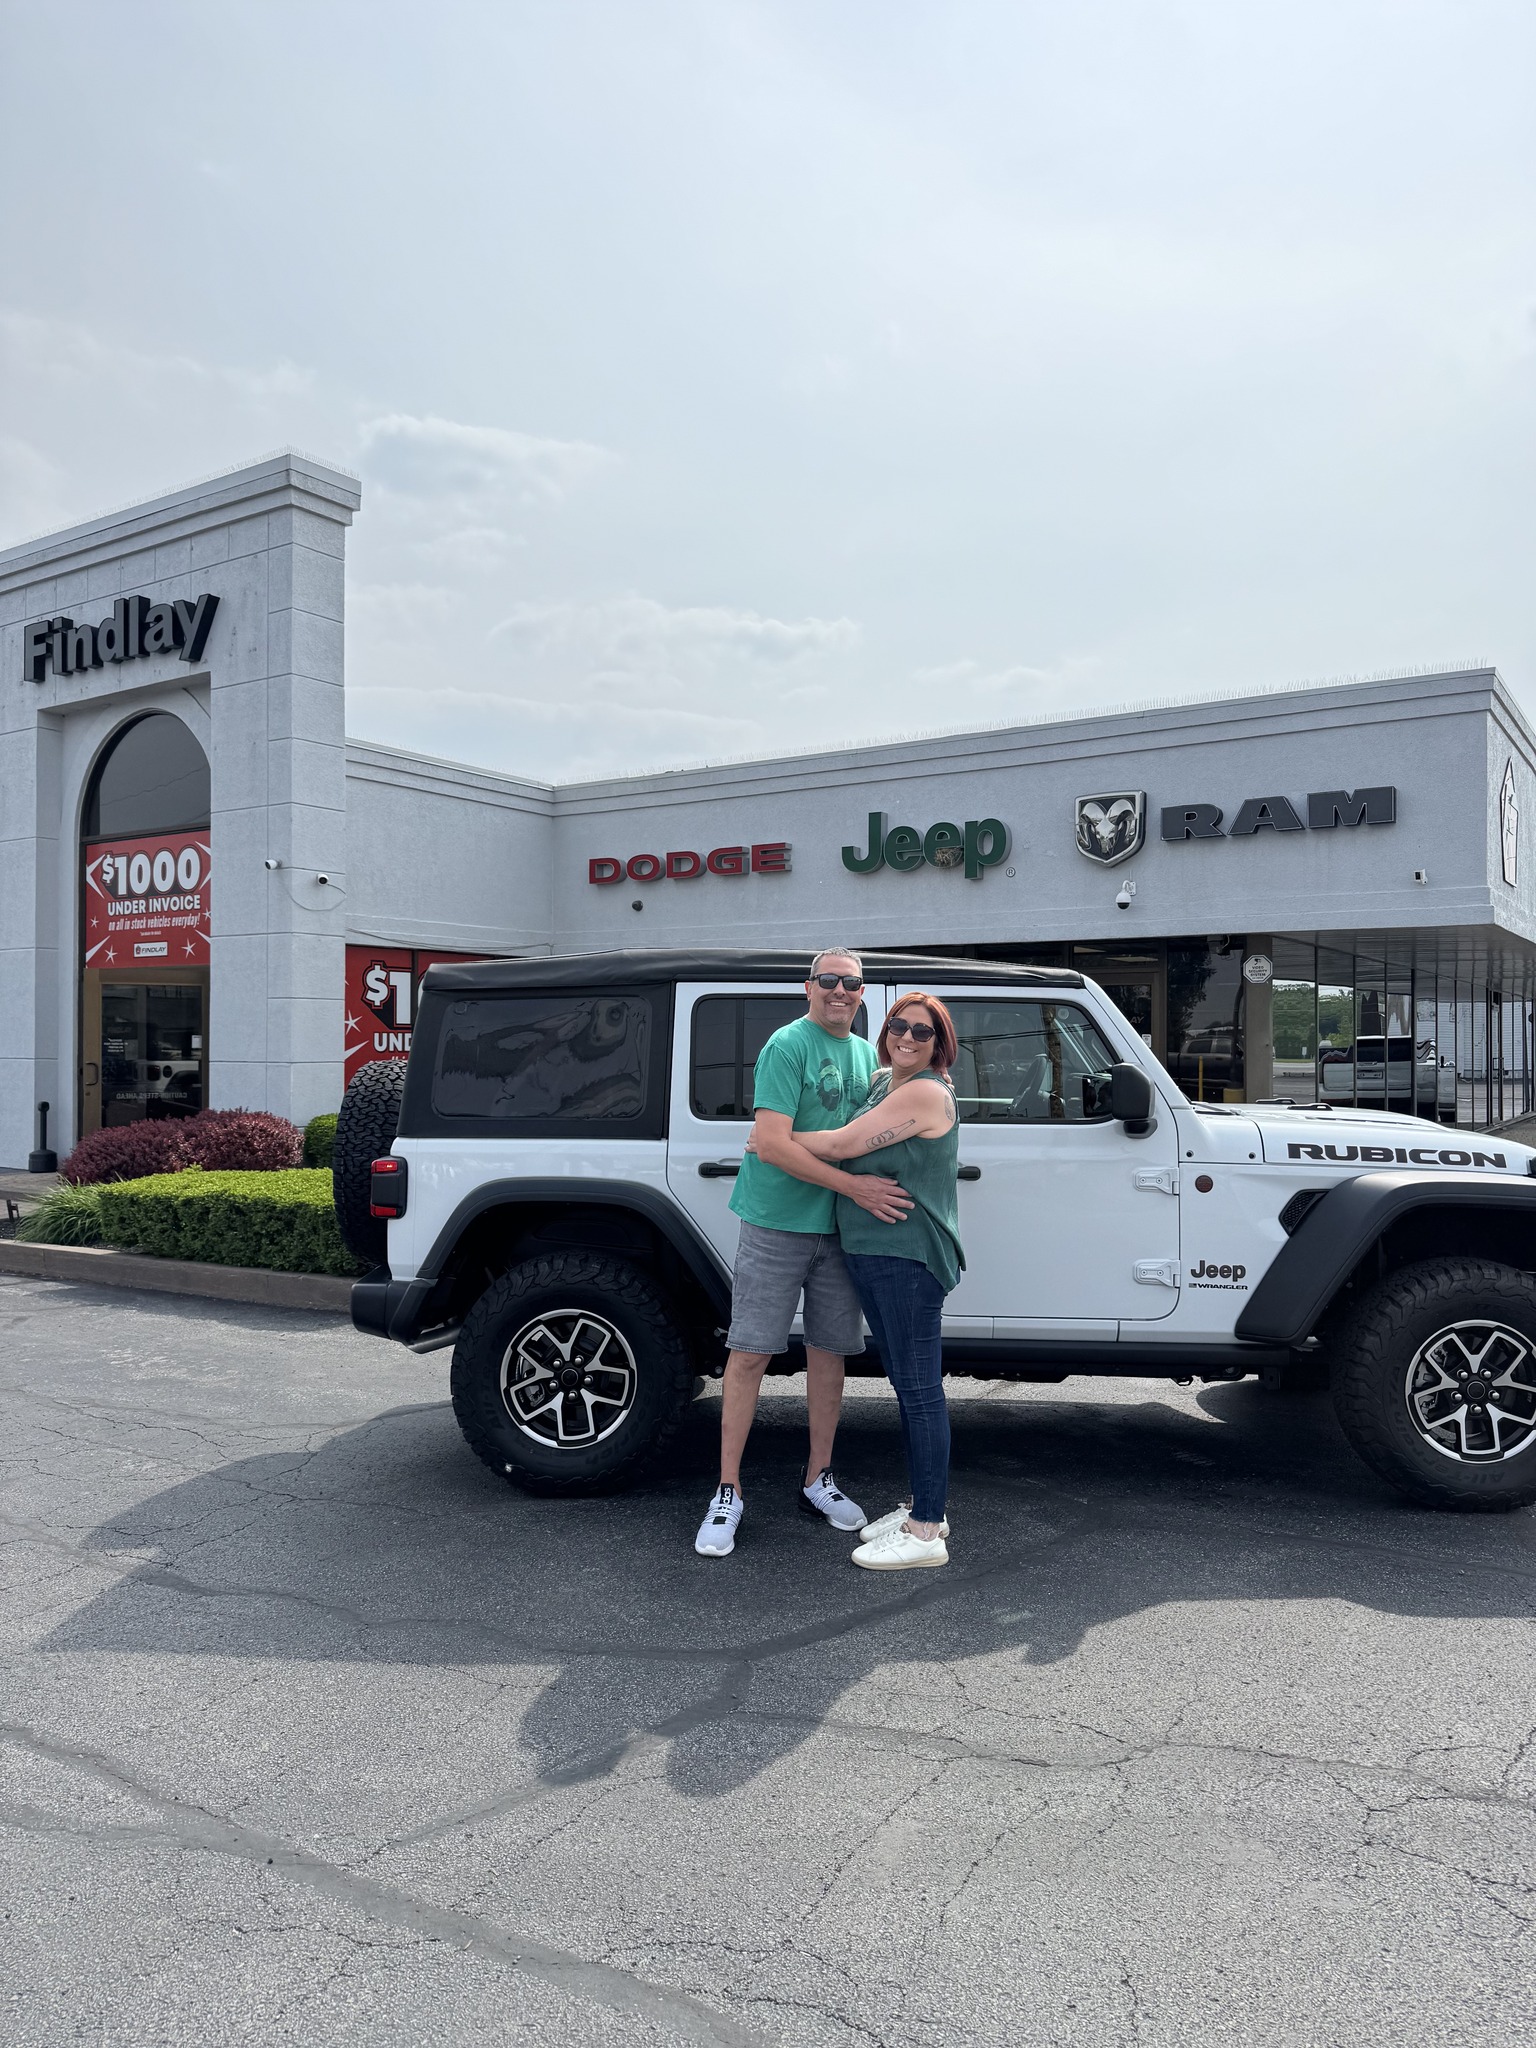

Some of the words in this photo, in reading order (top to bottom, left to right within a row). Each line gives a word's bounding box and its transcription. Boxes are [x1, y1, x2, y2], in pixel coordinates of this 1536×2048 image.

[24, 593, 220, 683] Findlay
[1160, 785, 1396, 842] RAM
[589, 842, 792, 885] DODGE
[842, 811, 1012, 880] Jeep
[102, 847, 201, 895] $1000
[107, 899, 146, 916] UNDER
[149, 895, 201, 913] INVOICE
[108, 921, 116, 931] on
[116, 919, 124, 931] all
[124, 918, 131, 930] in
[131, 917, 147, 930] stock
[147, 915, 171, 928] vehicles
[171, 912, 201, 929] everyday!
[141, 946, 167, 954] FINDLAY
[366, 964, 424, 1024] $1
[1287, 1143, 1507, 1168] RUBICON
[1190, 1260, 1246, 1282] Jeep
